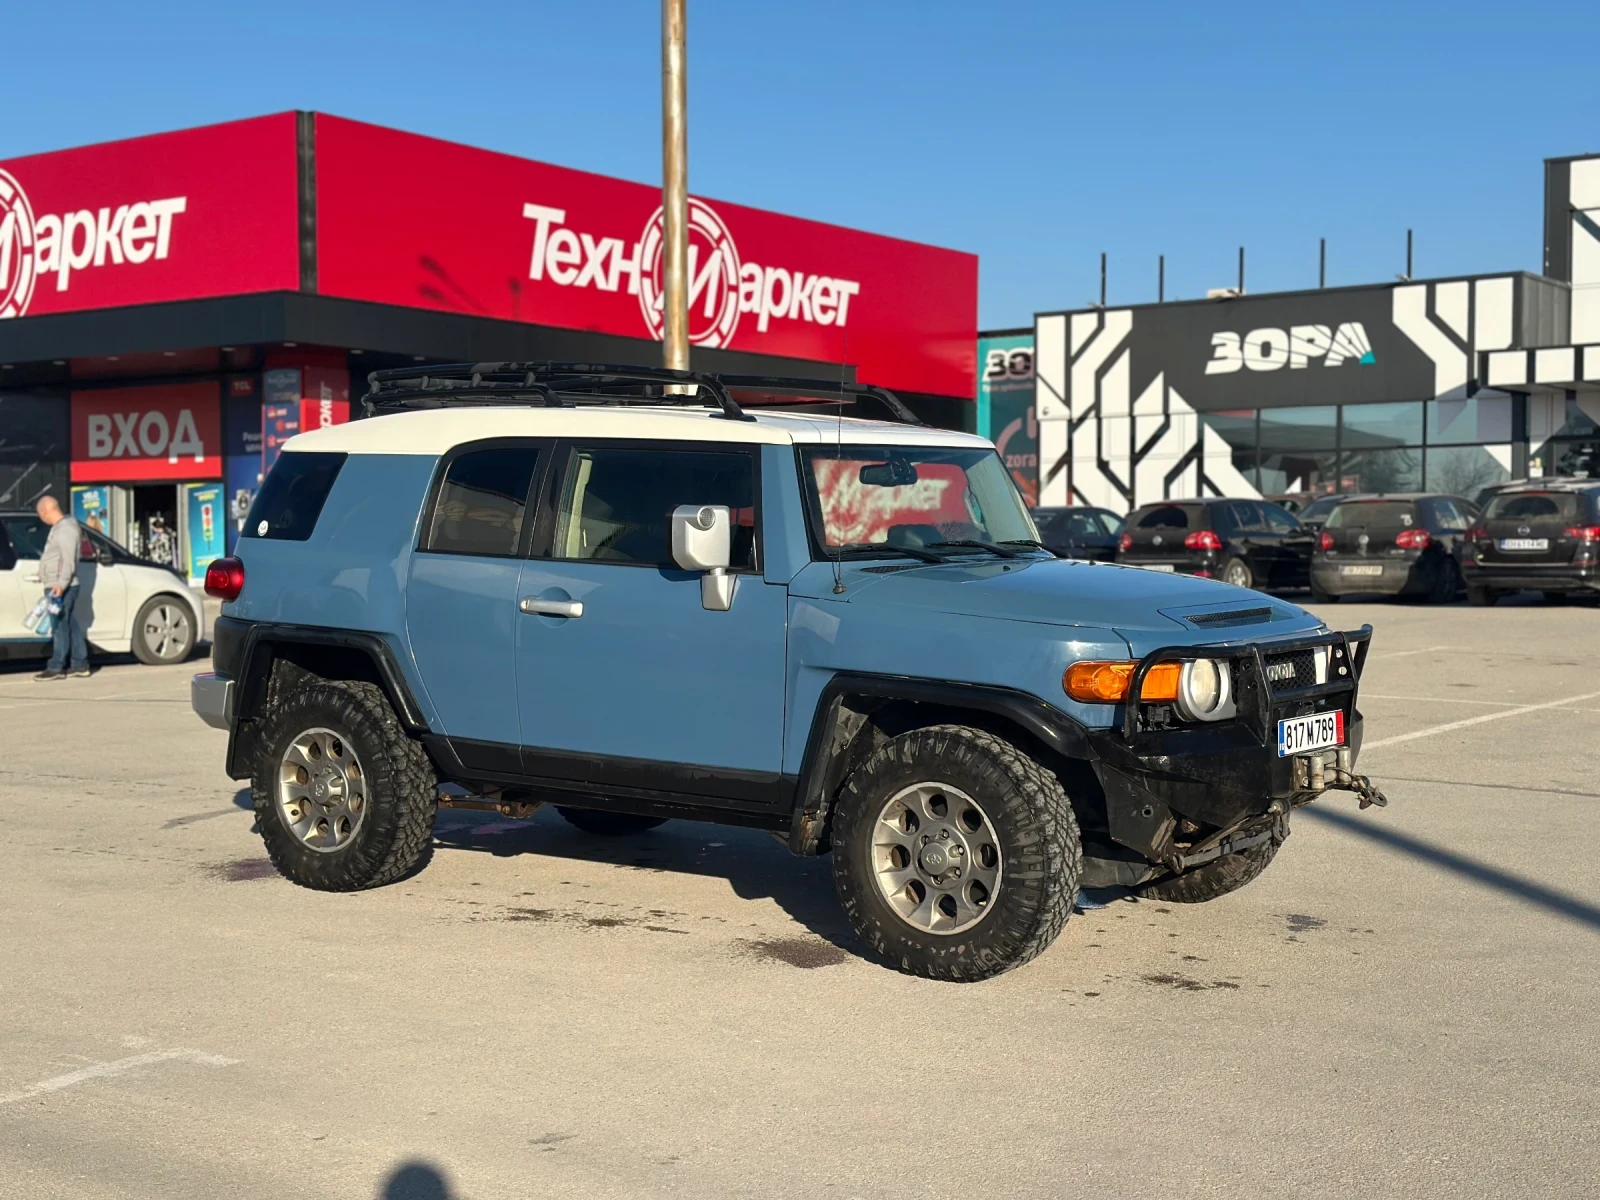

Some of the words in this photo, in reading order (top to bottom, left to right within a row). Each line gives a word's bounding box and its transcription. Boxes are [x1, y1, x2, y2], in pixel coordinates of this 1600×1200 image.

[982, 346, 1035, 382] ЗО
[1204, 321, 1376, 375] ЗОРА
[88, 409, 204, 463] ВХОД
[1266, 662, 1296, 681] OYOTA
[1286, 717, 1334, 749] 817M789
